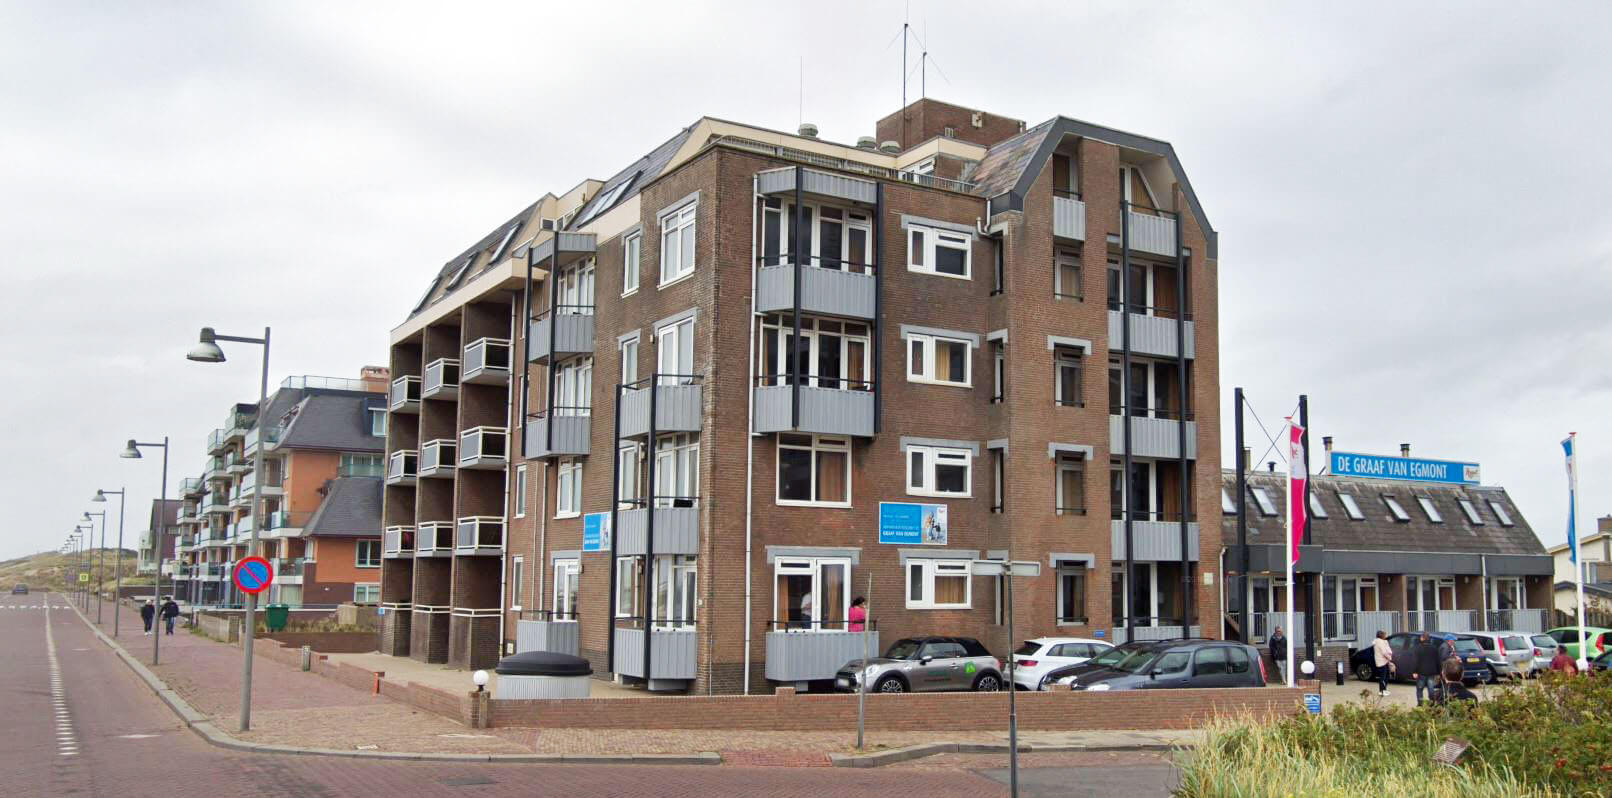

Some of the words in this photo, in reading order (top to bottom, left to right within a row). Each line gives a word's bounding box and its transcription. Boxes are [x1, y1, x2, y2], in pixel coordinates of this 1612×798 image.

[1338, 456, 1350, 472] DE
[1353, 457, 1385, 475] GRAAF
[1388, 460, 1408, 476] VAN
[1410, 462, 1447, 479] EGMONT
